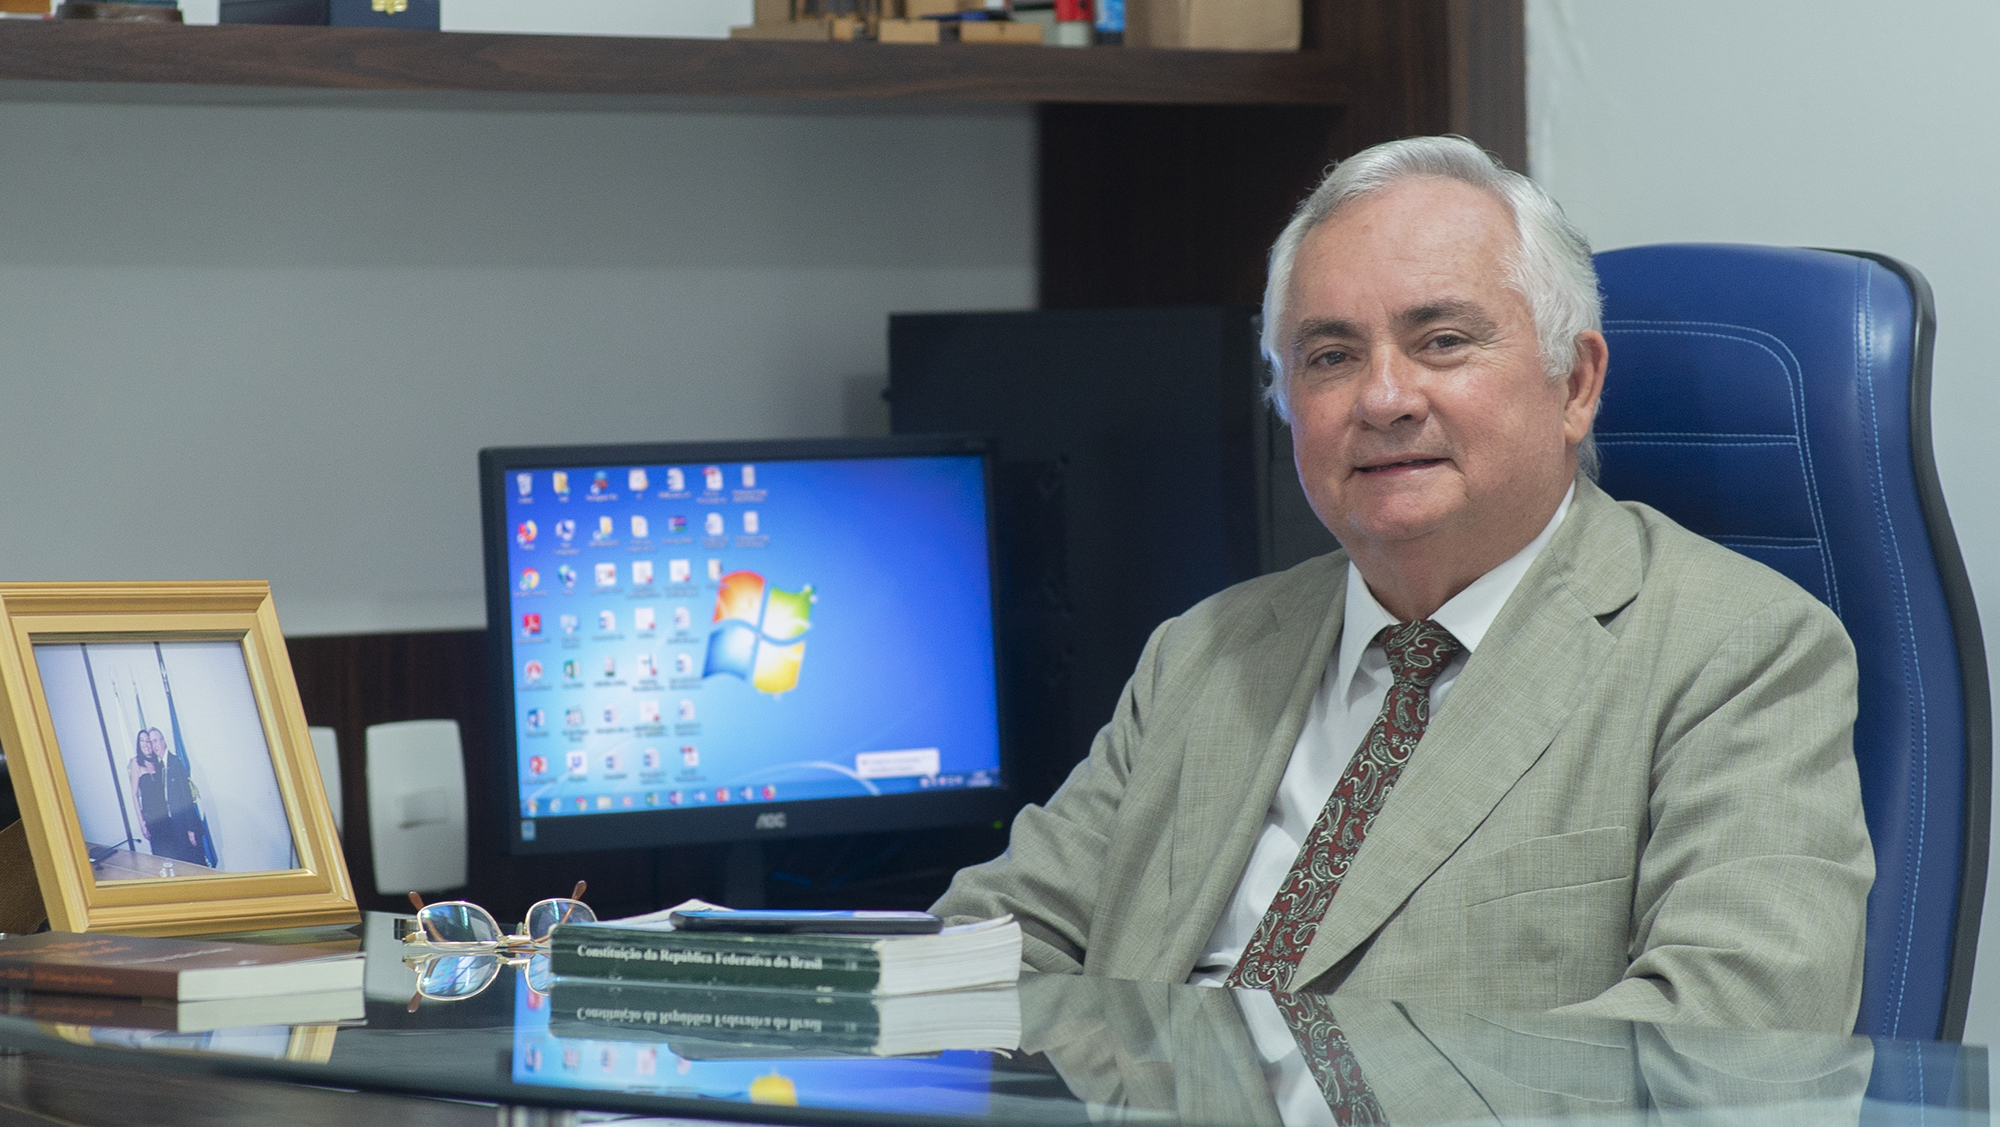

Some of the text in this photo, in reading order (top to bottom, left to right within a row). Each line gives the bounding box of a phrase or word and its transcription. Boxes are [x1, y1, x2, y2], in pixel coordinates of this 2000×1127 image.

[577, 944, 823, 970] Constituição da República Federativa do Brasil
